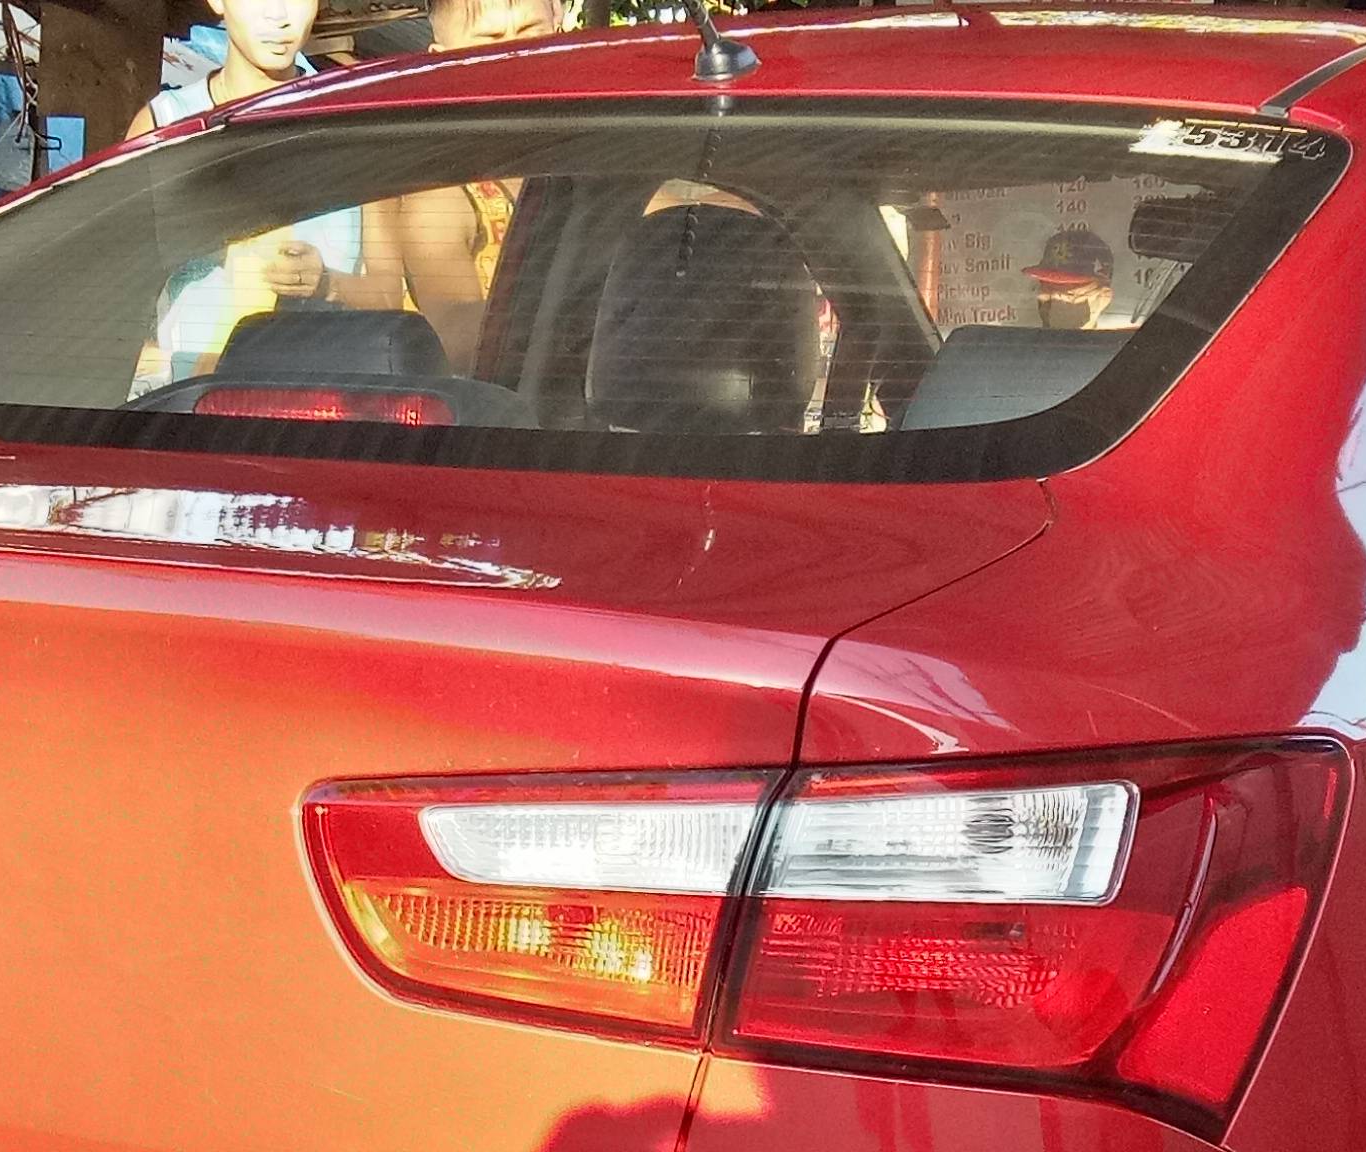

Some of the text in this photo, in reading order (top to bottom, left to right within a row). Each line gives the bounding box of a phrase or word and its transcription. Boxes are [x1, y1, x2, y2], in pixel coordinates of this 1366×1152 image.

[965, 233, 991, 250] Big
[965, 253, 1011, 273] Small
[971, 304, 1017, 323] Truck
